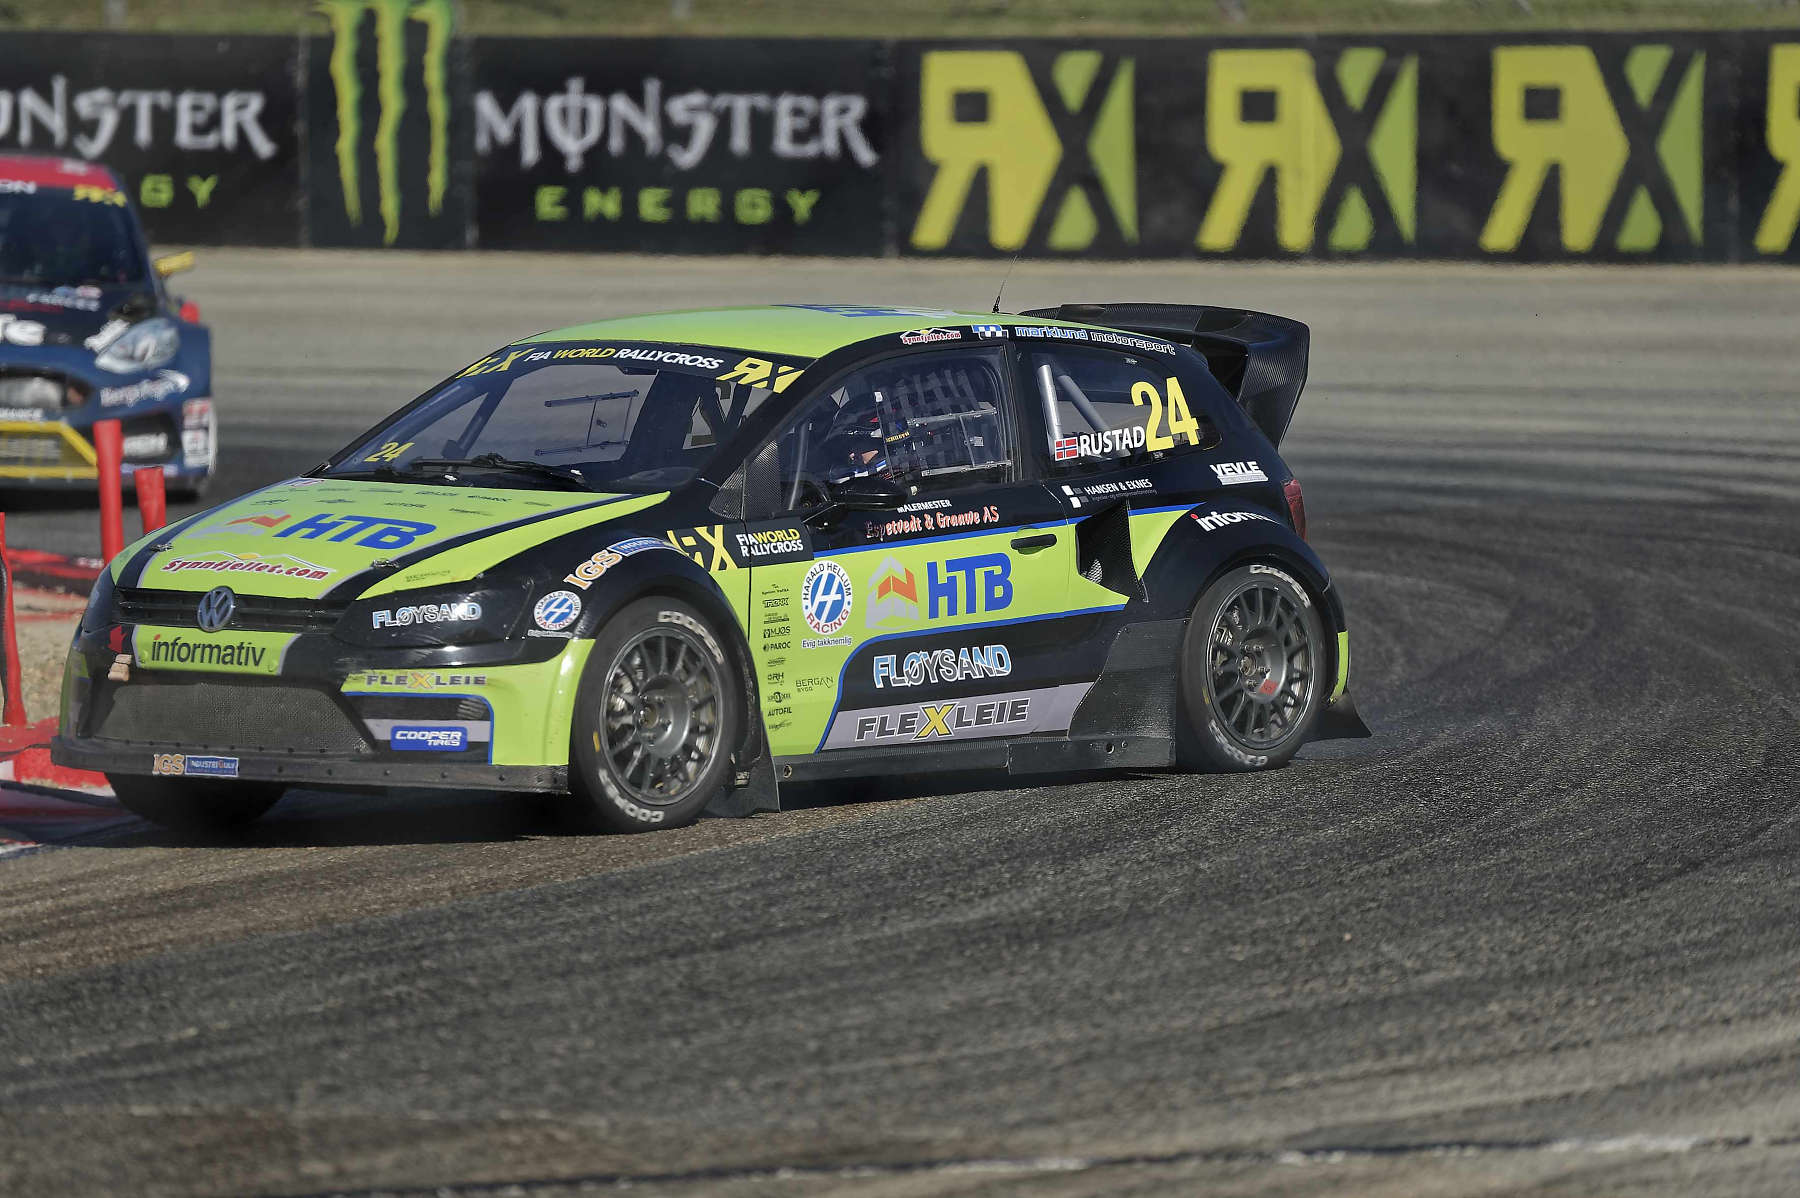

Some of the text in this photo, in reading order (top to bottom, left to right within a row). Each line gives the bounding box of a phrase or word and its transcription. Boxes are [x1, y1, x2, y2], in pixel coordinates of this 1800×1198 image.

[474, 76, 878, 172] MONSTER
[535, 185, 820, 225] ENERGY
[1015, 326, 1176, 356] marklund motorsport
[523, 350, 552, 362] FIA
[553, 348, 616, 360] WORLD
[613, 348, 724, 370] RALLYCROSS
[1131, 376, 1200, 452] 24
[364, 441, 415, 462] 24
[1078, 425, 1146, 457] RUSTAD
[1084, 482, 1119, 495] HANSEN
[1118, 482, 1127, 490] &
[1125, 478, 1153, 489] EKNES
[272, 513, 437, 549] HTB
[924, 513, 935, 530] &
[982, 505, 1000, 523] AS
[741, 540, 804, 557] RALLYCROSS
[563, 549, 623, 590] IGS
[803, 563, 852, 600] HARALD HELLUM
[926, 552, 1013, 620] HTB
[372, 602, 482, 629] FLØYSAND
[807, 608, 849, 634] RACING
[151, 634, 266, 667] informativ
[802, 636, 852, 649] Evig takknemlig
[365, 671, 487, 690] FLEXLEIE
[874, 644, 1012, 689] FLØYSAND
[855, 698, 1031, 742] FLEXLEIE
[395, 730, 462, 740] COOPER
[426, 739, 460, 747] TIRES
[152, 753, 184, 776] IGS
